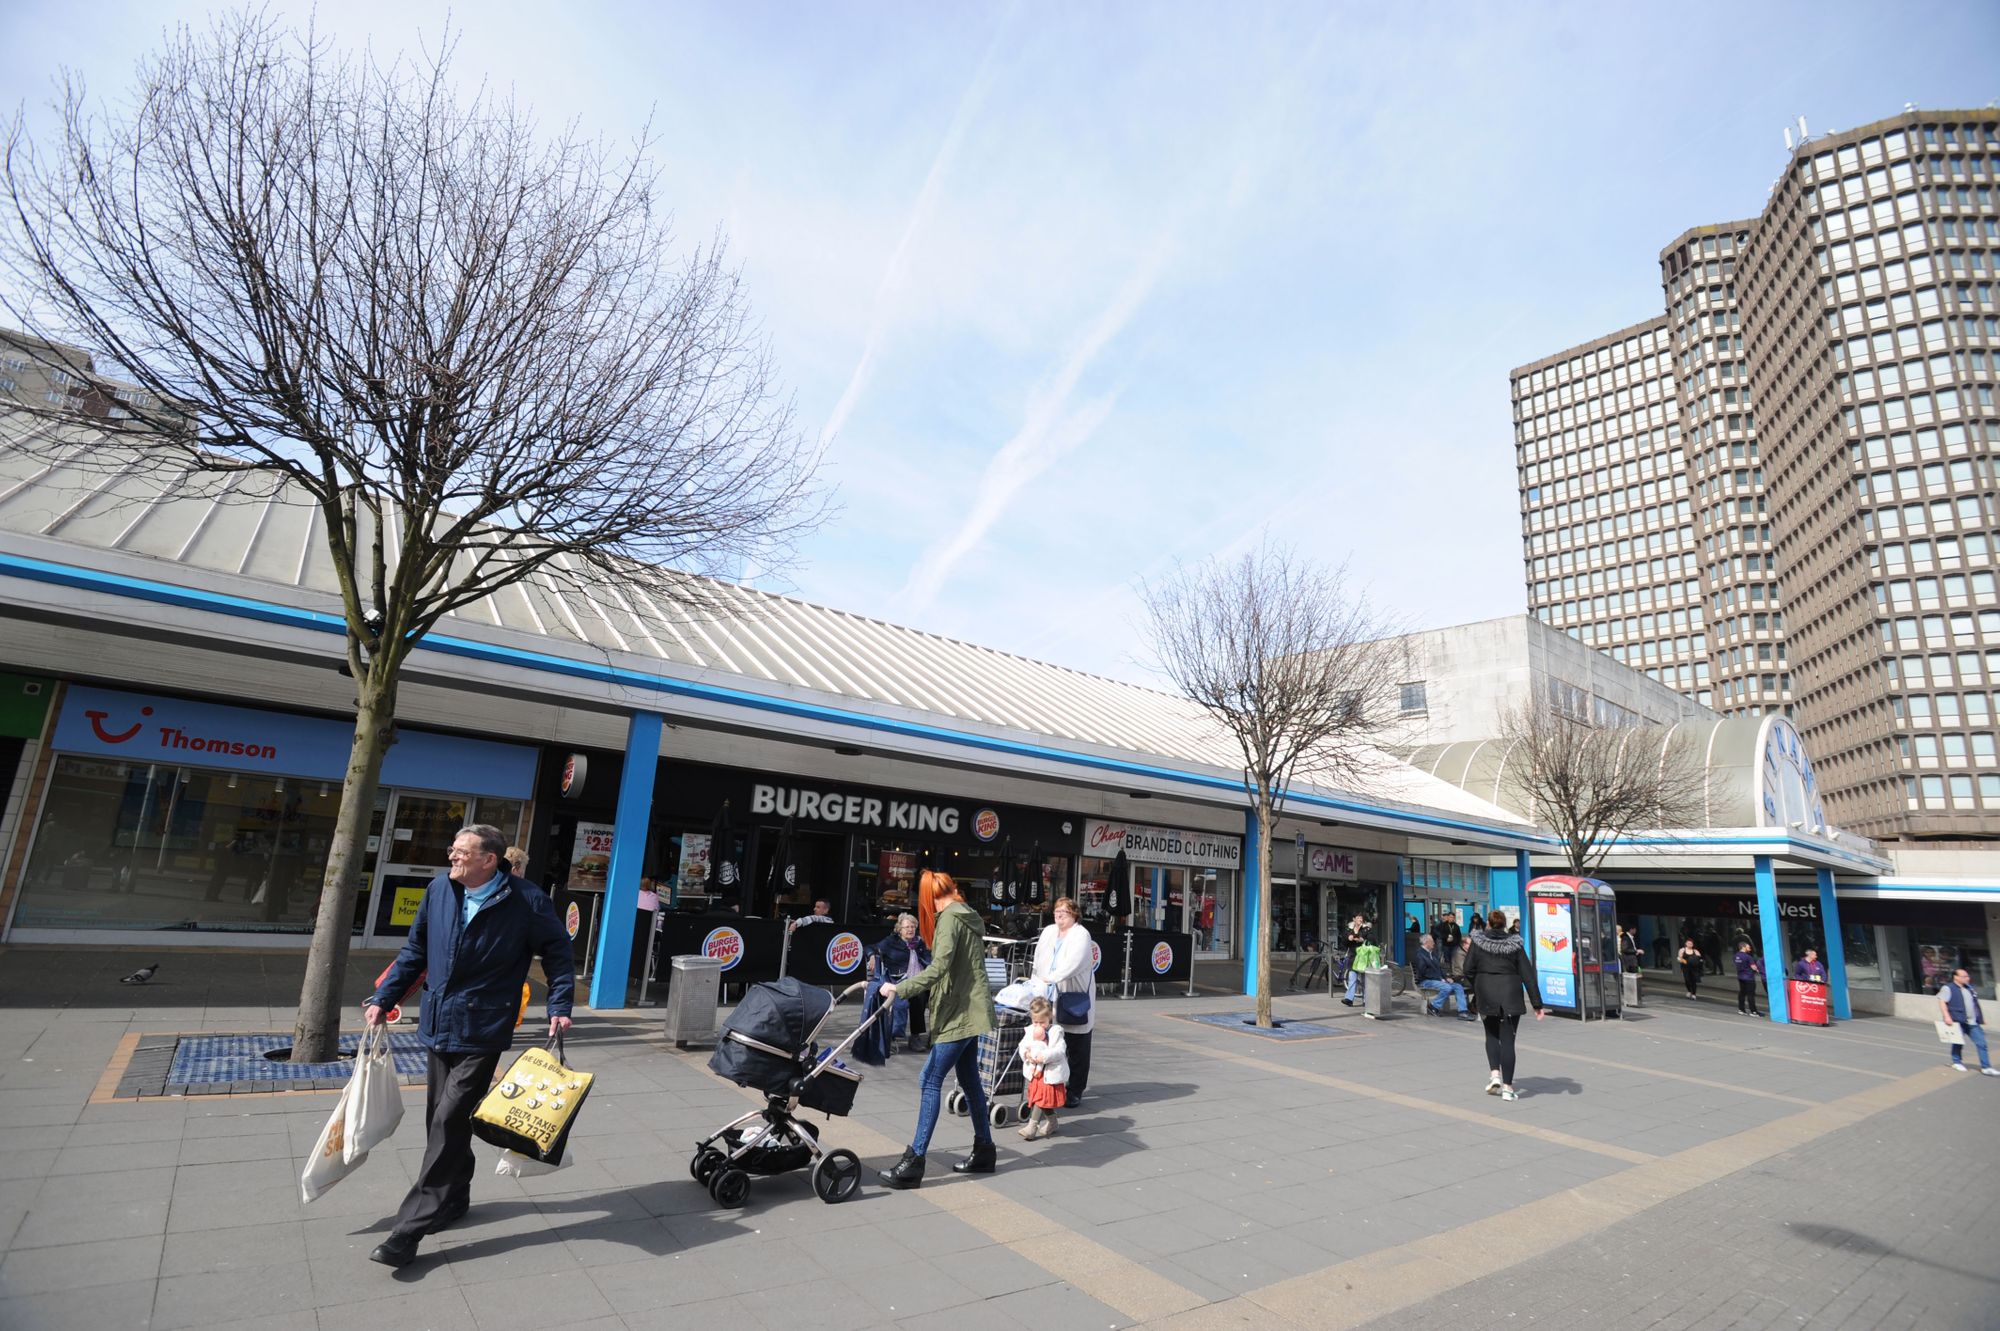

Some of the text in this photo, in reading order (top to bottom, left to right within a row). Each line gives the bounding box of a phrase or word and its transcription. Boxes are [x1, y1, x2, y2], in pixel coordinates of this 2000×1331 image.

[160, 727, 277, 760] Thomson
[752, 784, 960, 834] BURGER KING
[976, 821, 997, 833] KING
[977, 813, 997, 826] BURGER
[1091, 824, 1126, 849] Cheap
[1125, 834, 1239, 860] BRANDED CLOTHING
[1312, 849, 1354, 874] GAME
[403, 898, 421, 907] Trav
[1738, 900, 1817, 918] NaWest
[398, 907, 418, 916] Mon
[707, 936, 739, 950] BURGER
[707, 943, 740, 958] KING
[832, 940, 859, 954] BURGER
[832, 949, 860, 964] KING
[1155, 954, 1171, 966] KING
[508, 1106, 557, 1133] DELTA TAXIS
[504, 1115, 552, 1144] 922 7373
